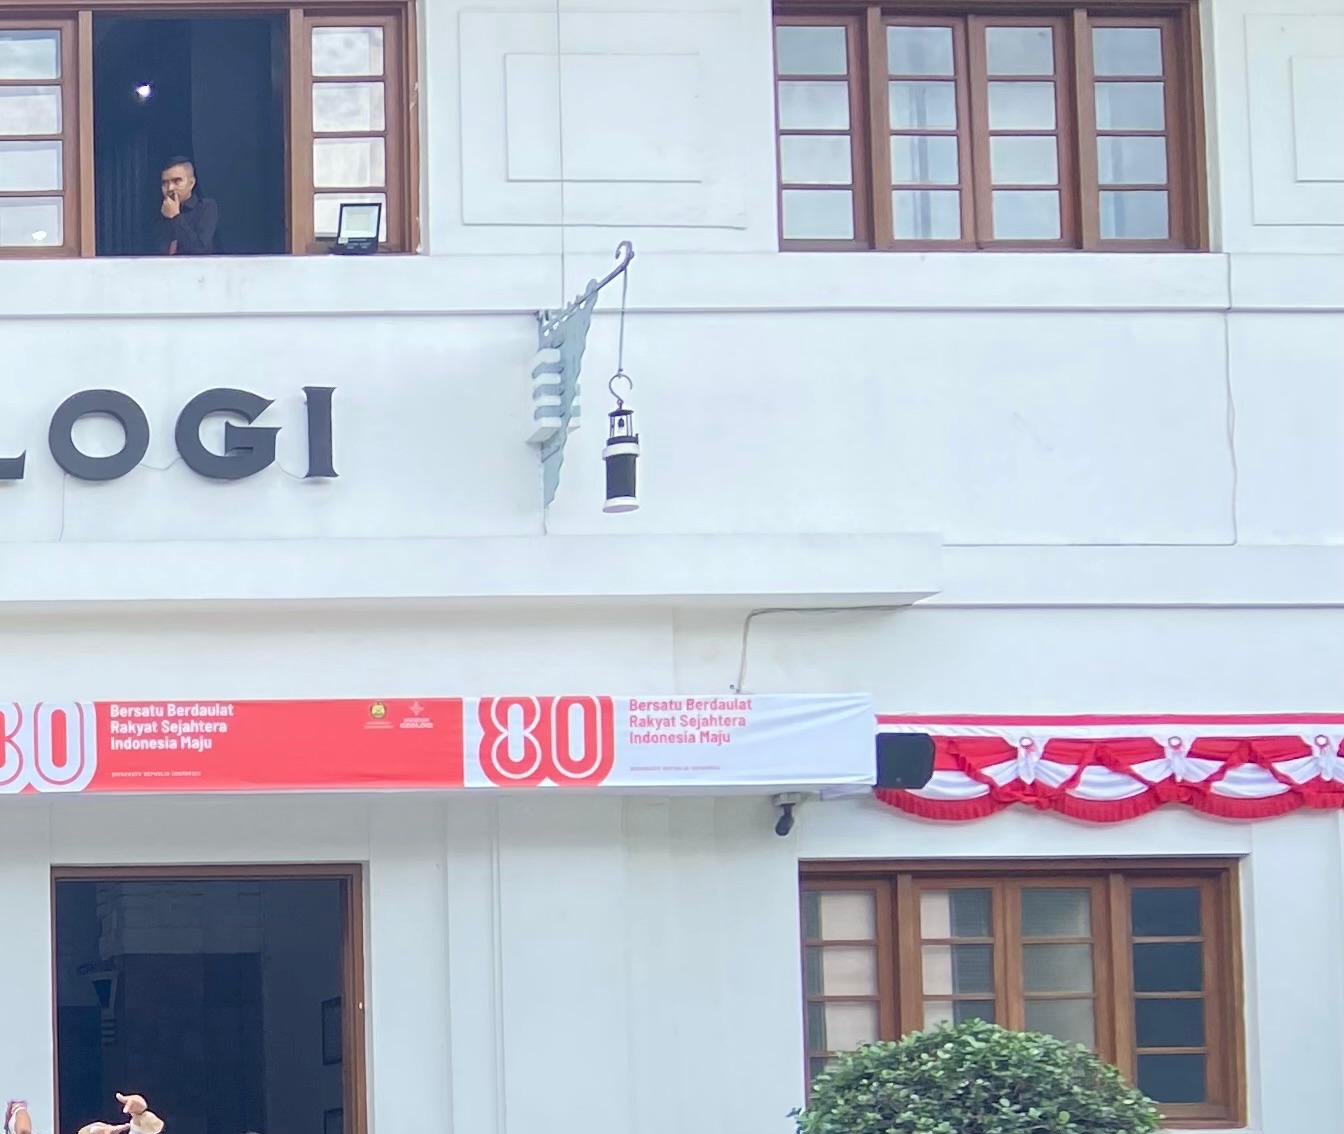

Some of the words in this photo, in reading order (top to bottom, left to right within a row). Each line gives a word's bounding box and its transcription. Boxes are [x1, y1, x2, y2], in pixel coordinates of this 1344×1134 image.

[110, 704, 164, 718] Bersatu
[167, 703, 234, 717] Berdaulat
[629, 698, 682, 711] Bersatu
[686, 698, 752, 711] Berdaulat
[110, 720, 158, 737] Rakyat
[161, 720, 228, 736] Sejahtera
[629, 715, 676, 731] Rakyat
[679, 715, 746, 731] Sejahtera
[110, 736, 177, 751] Indonesia
[180, 736, 212, 752] Maju
[478, 695, 616, 787] 80
[629, 731, 696, 744] Indonesia
[699, 731, 731, 747] Maju
